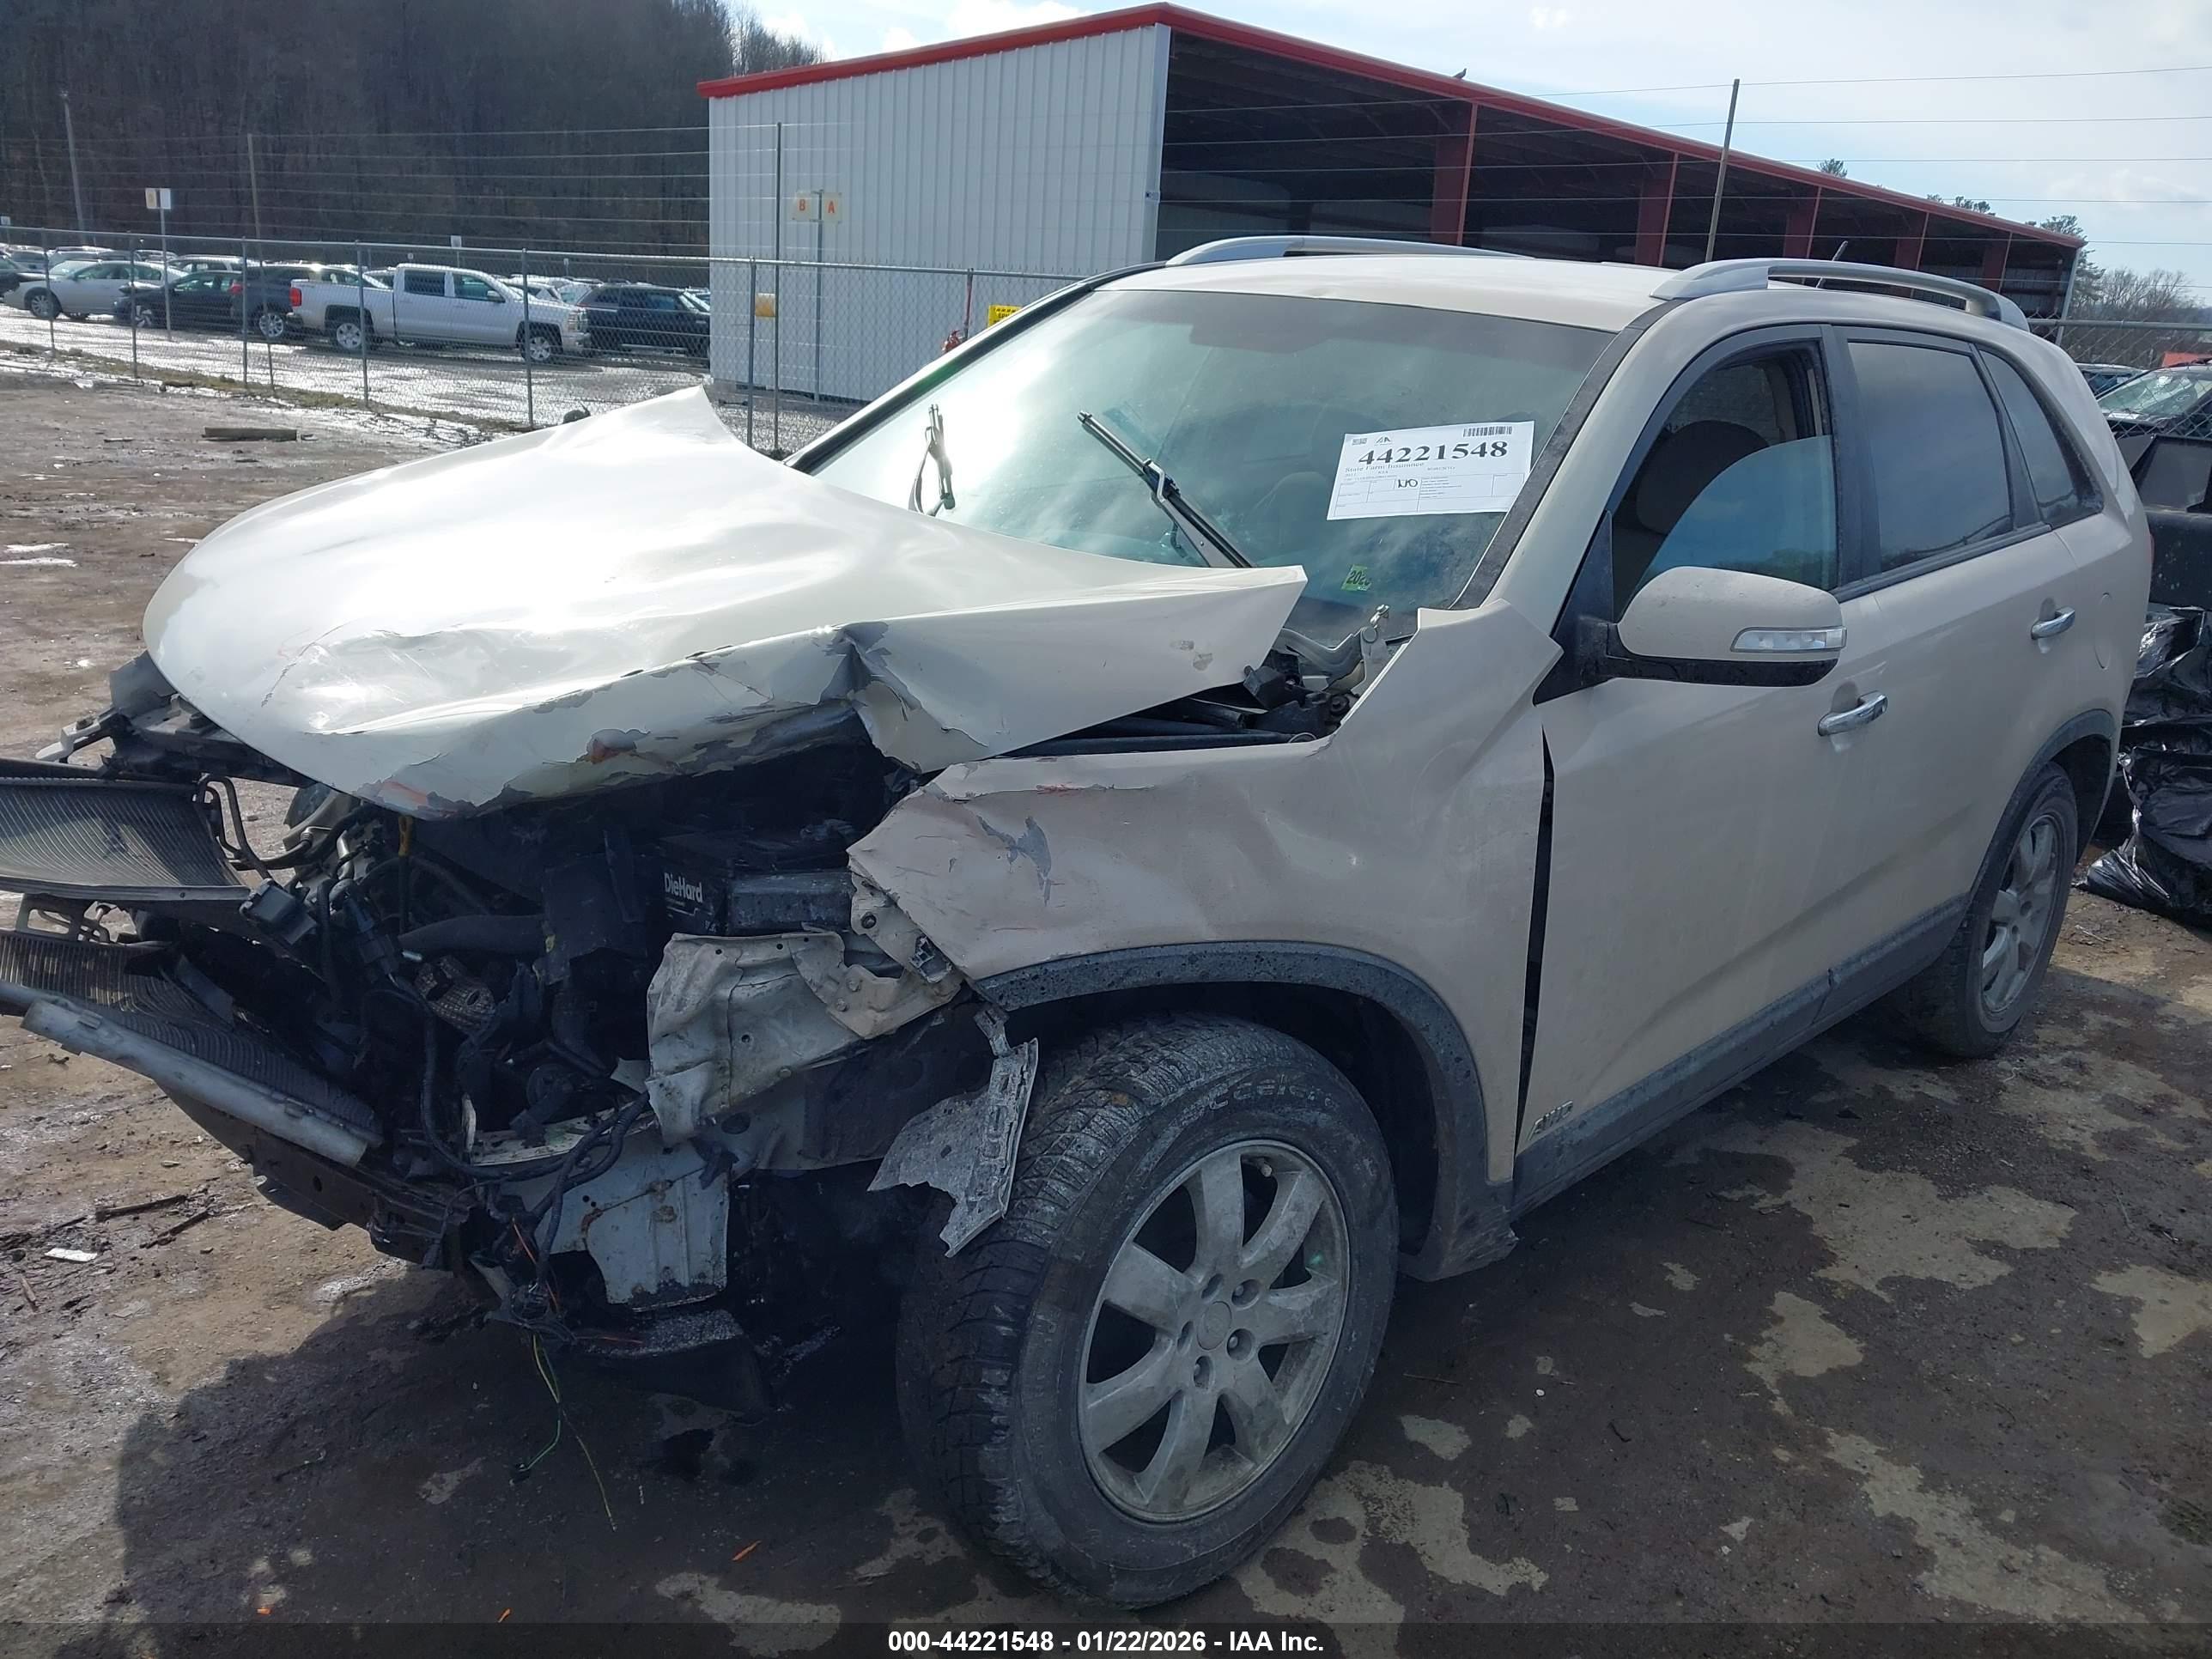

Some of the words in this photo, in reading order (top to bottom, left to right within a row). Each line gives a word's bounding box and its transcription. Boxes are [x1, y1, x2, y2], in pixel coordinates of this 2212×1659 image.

[799, 198, 805, 211] B
[827, 200, 836, 214] A
[1358, 441, 1508, 465] 44221548
[664, 872, 703, 903] DieHard
